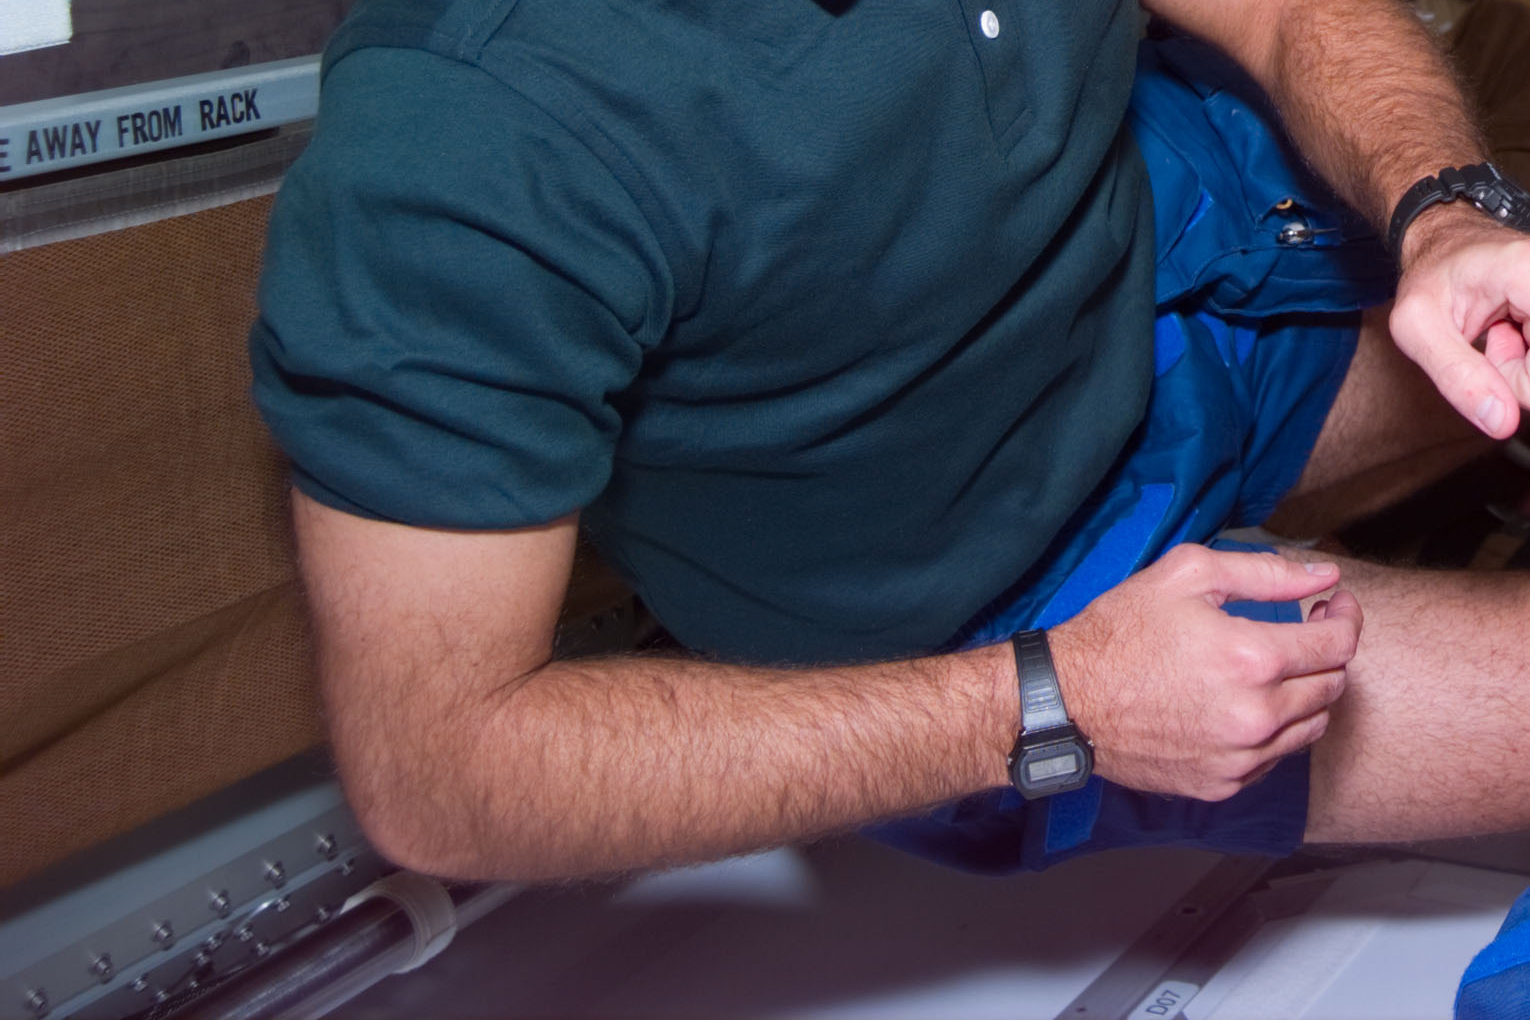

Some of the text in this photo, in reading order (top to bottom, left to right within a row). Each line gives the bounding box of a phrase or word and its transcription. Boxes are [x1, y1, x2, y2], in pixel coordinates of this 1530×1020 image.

[25, 119, 102, 165] AWAY
[116, 105, 184, 148] FROM
[198, 88, 262, 131] RACK
[1145, 989, 1181, 1016] D07
